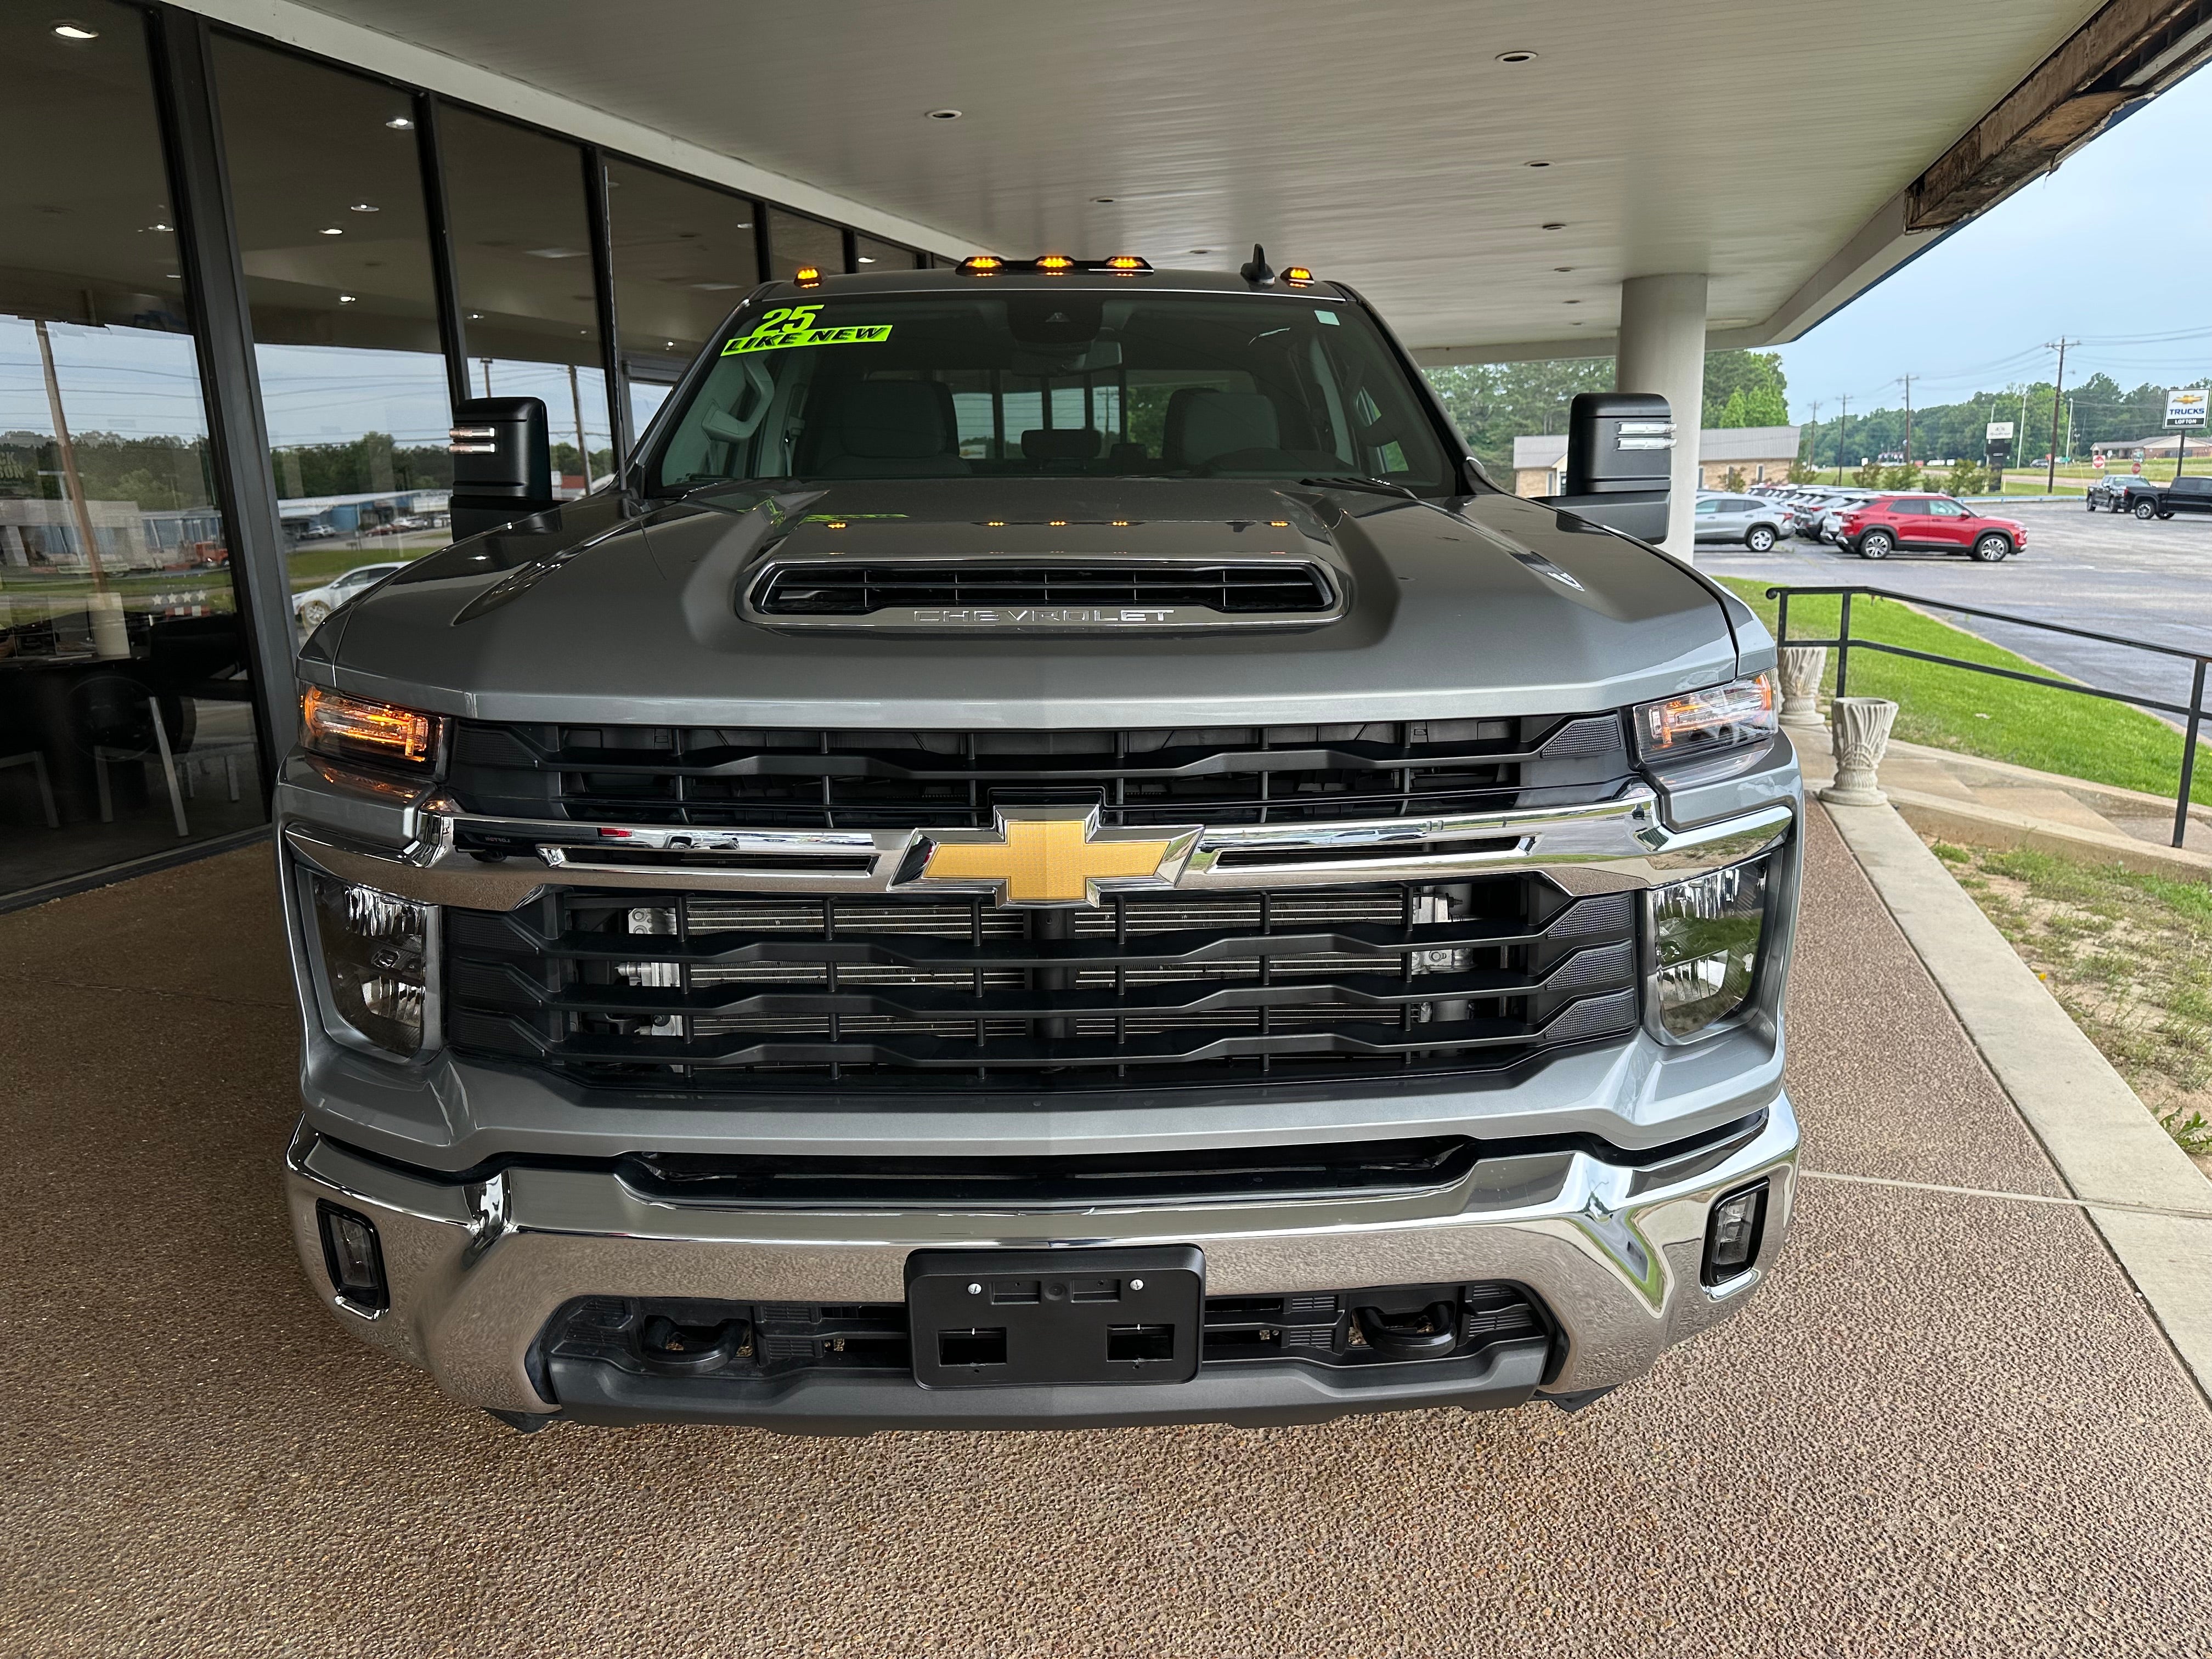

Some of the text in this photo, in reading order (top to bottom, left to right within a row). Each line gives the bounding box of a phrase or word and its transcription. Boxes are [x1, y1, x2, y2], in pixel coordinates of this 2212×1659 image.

[752, 304, 825, 336] 25
[724, 328, 885, 353] LIKE NEW
[913, 609, 1175, 622] CHEVROLET
